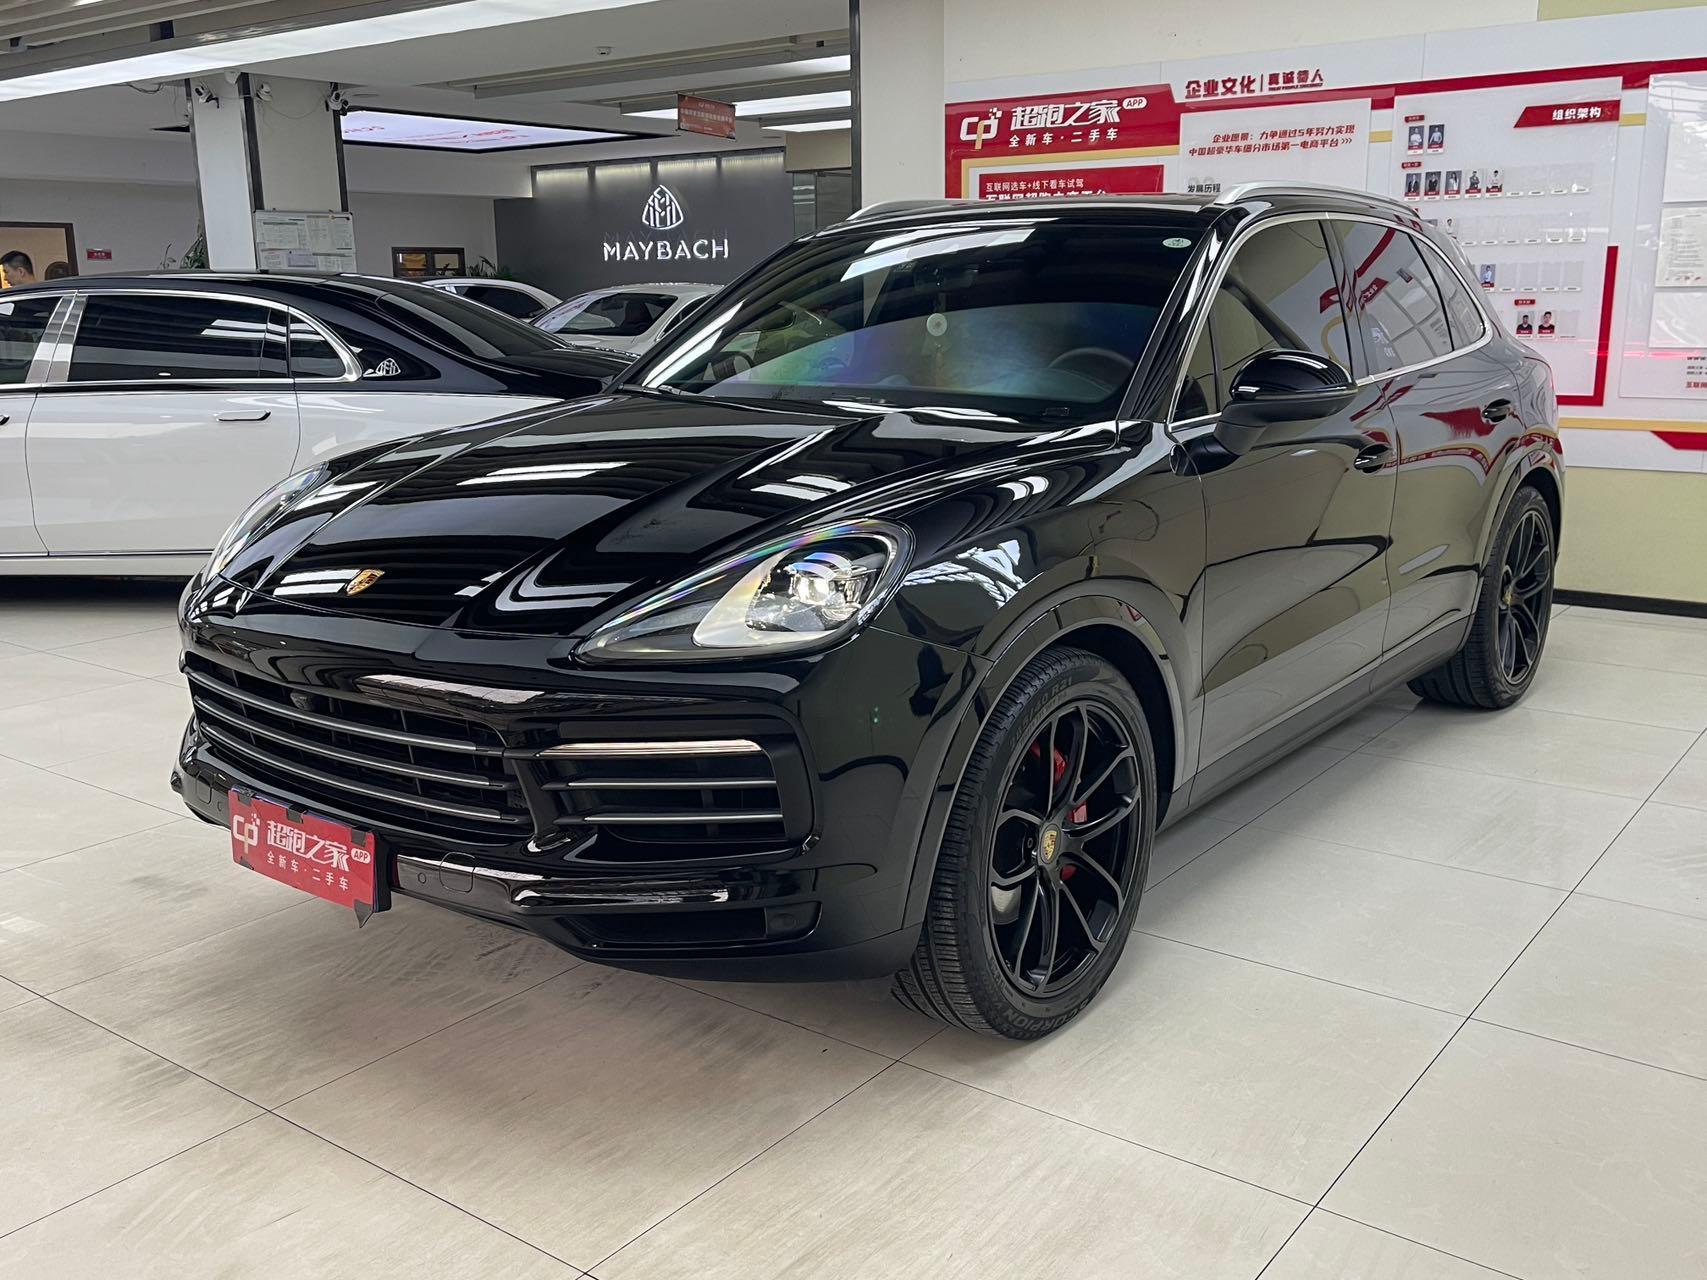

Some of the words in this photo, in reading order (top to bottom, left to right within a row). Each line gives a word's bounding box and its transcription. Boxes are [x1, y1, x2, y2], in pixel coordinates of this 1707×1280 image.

[1185, 74, 1256, 99] 企业文化
[1010, 100, 1120, 130] 超跑之家
[1126, 98, 1144, 108] APP
[1552, 107, 1601, 121] 组织架构
[603, 239, 729, 261] MAYBACH
[267, 820, 350, 872] 超跑之家
[353, 851, 369, 863] APP
